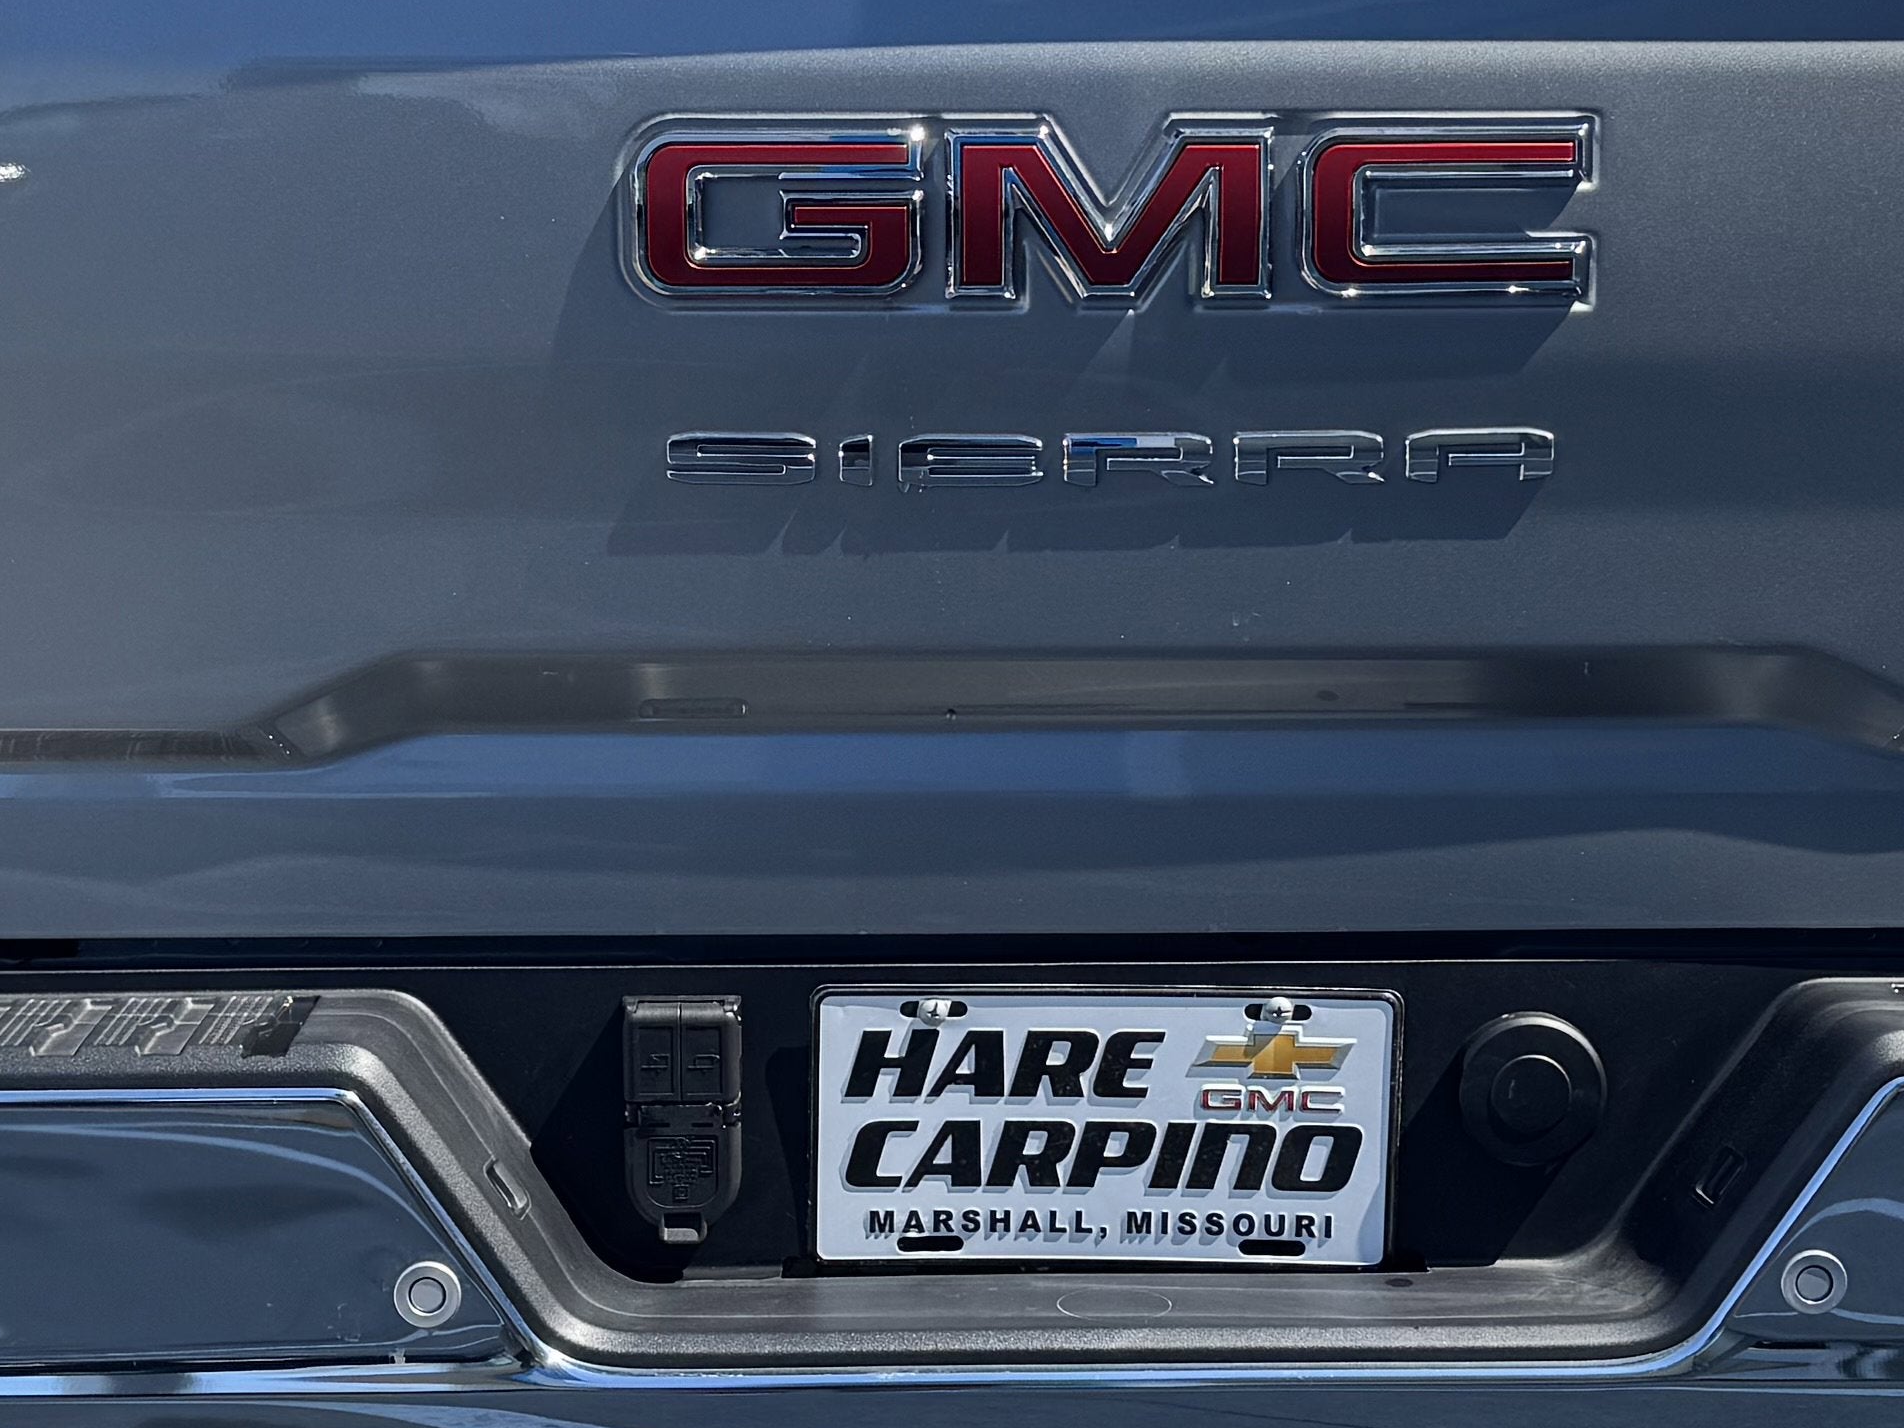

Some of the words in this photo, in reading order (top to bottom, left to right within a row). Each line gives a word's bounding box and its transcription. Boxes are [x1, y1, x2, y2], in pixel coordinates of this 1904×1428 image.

[631, 112, 1599, 312] GMC
[666, 431, 1555, 488] SIERRA
[844, 1029, 1165, 1098] HARE
[1200, 1084, 1345, 1113] GMC
[845, 1119, 1364, 1192] CARPINO
[869, 1209, 1108, 1239] MARSHALL,
[1126, 1210, 1333, 1239] MISSOURI
